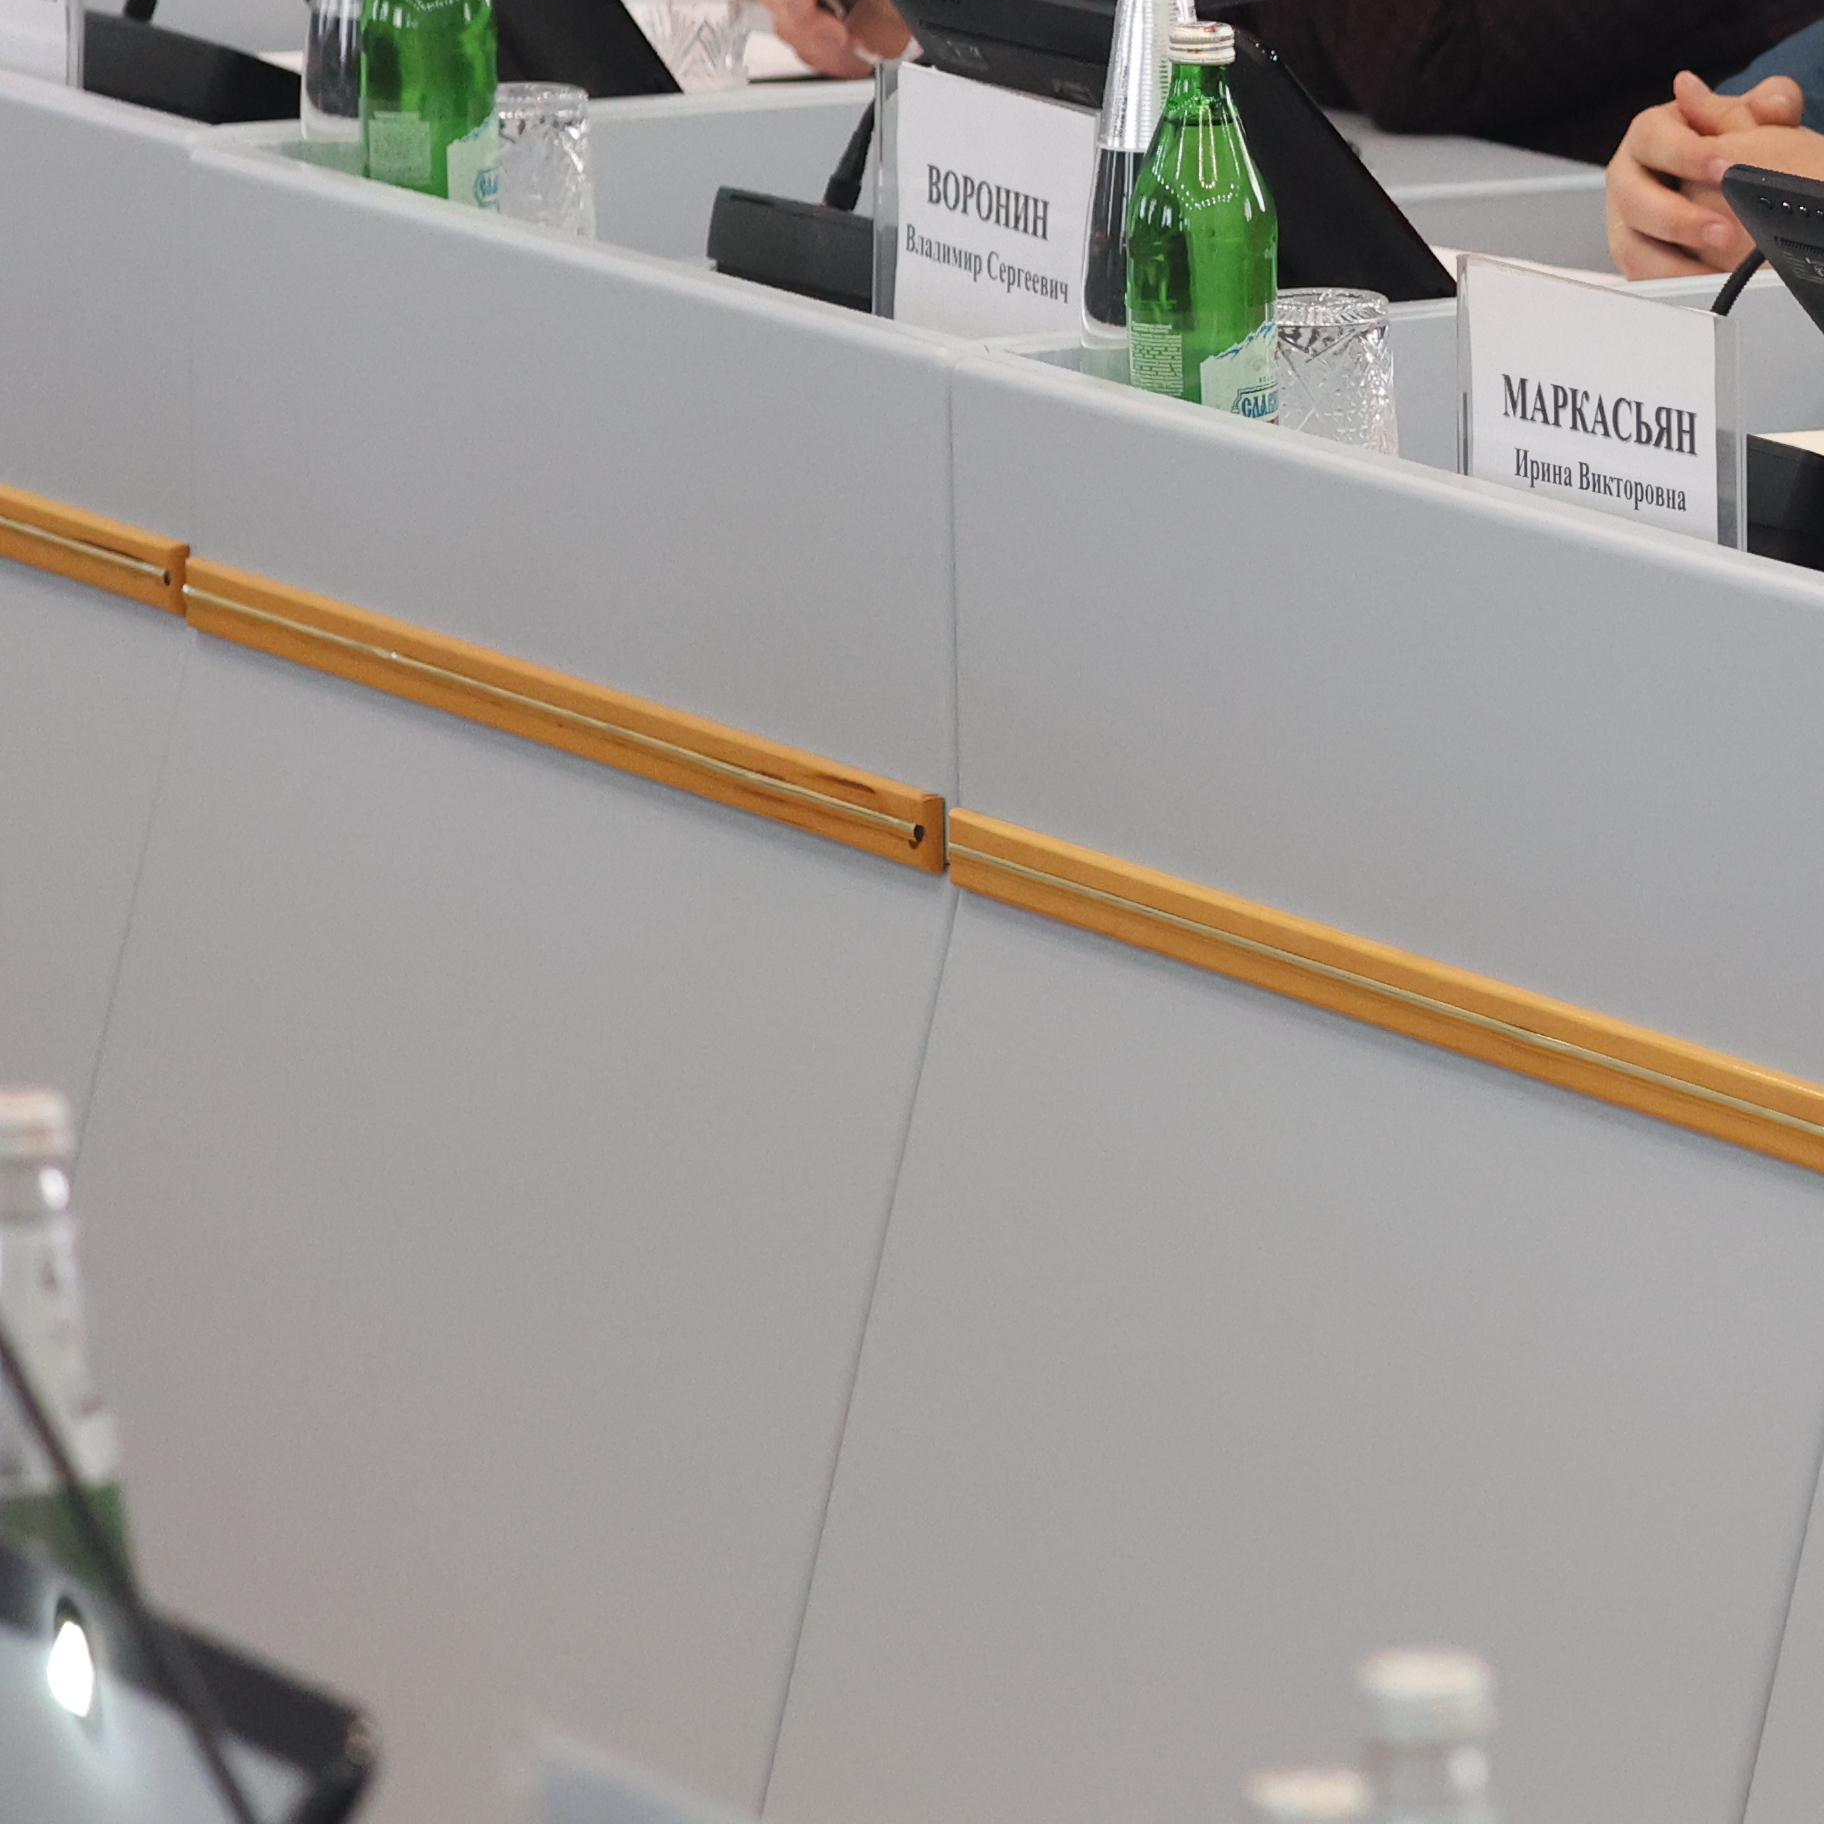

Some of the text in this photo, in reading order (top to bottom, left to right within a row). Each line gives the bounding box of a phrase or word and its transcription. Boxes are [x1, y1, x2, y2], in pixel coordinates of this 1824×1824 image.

[927, 164, 1050, 241] ВОРОНИН
[905, 223, 1070, 304] Владимир Сергеевич
[1501, 374, 1698, 456] МАРКАСЬЯН
[1514, 447, 1687, 513] Ирина Викторовна
